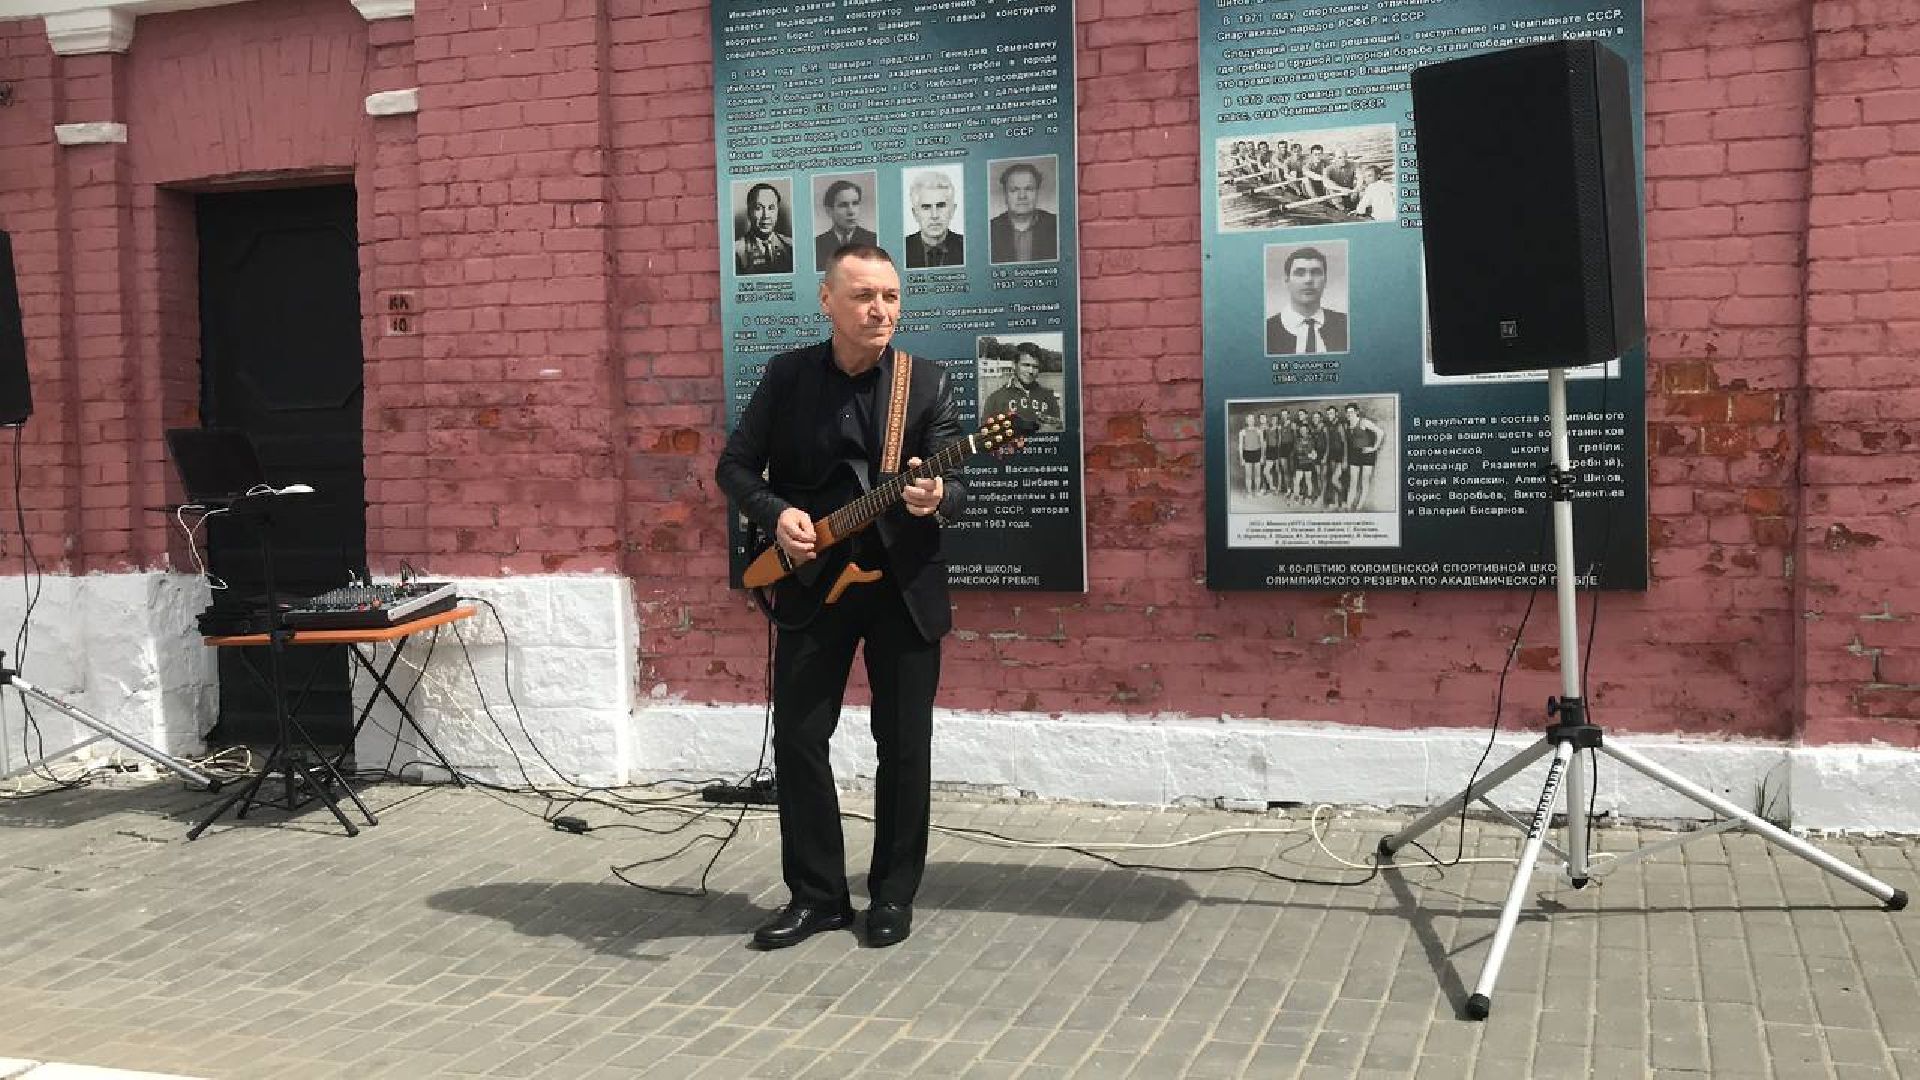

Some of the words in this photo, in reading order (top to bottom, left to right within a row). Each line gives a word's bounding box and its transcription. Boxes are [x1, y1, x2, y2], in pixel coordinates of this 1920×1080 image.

[996, 4, 1056, 17] конструктор
[1302, 3, 1368, 16] спортсмены
[1289, 22, 1333, 33] народов
[1337, 15, 1378, 27] РСФСР
[1391, 10, 1424, 22] СССР
[1222, 44, 1285, 58] Следующий
[1290, 43, 1309, 51] шаг
[1314, 40, 1336, 49] был
[1339, 32, 1400, 48] решающий
[1415, 25, 1487, 39] выступление
[1510, 16, 1581, 29] Чемпионате
[1586, 10, 1623, 22] СССР.
[866, 36, 888, 45] бюро
[996, 40, 1056, 53] Семеновичу
[1288, 54, 1331, 67] трудной
[1344, 49, 1390, 62] упорной
[1392, 45, 1432, 56] борьбе
[1436, 43, 1468, 52] стали
[1562, 28, 1612, 40] Команду
[1358, 63, 1415, 75] Владимир
[984, 96, 1057, 110] академической
[960, 131, 994, 140] спорта
[1004, 126, 1034, 137] СССР
[1008, 398, 1048, 412] СССР
[1425, 418, 1486, 427] результате
[1406, 446, 1482, 456] коломенской
[963, 466, 998, 474] Бориса
[969, 479, 1018, 488] Александр
[1022, 478, 1059, 487] Шибаев
[1406, 477, 1446, 486] Сергей
[978, 492, 1046, 501] победителями
[1407, 493, 1441, 501] Борис
[1419, 505, 1466, 515] Валерий
[984, 520, 1006, 528] 1963
[947, 564, 982, 574] ИВНОЙ
[984, 565, 1022, 573] ШКОЛЫ
[1289, 564, 1346, 573] 60-ЛЕТИЮ
[1350, 562, 1439, 573] КОЛОМЕНСКОЙ
[1443, 562, 1526, 572] СПОРТИВНОЙ
[1530, 563, 1557, 572] ШКО
[1002, 576, 1040, 585] ГРЕБЛЕ
[1266, 575, 1360, 586] ОЛИМПИЙСКОГО
[1364, 576, 1416, 586] РЕЗЕРВА
[1419, 576, 1437, 586] ПО
[1440, 575, 1547, 586] АКАДЕМИЧЕСКОЙ
[1551, 576, 1599, 586] ГБЛЕ
